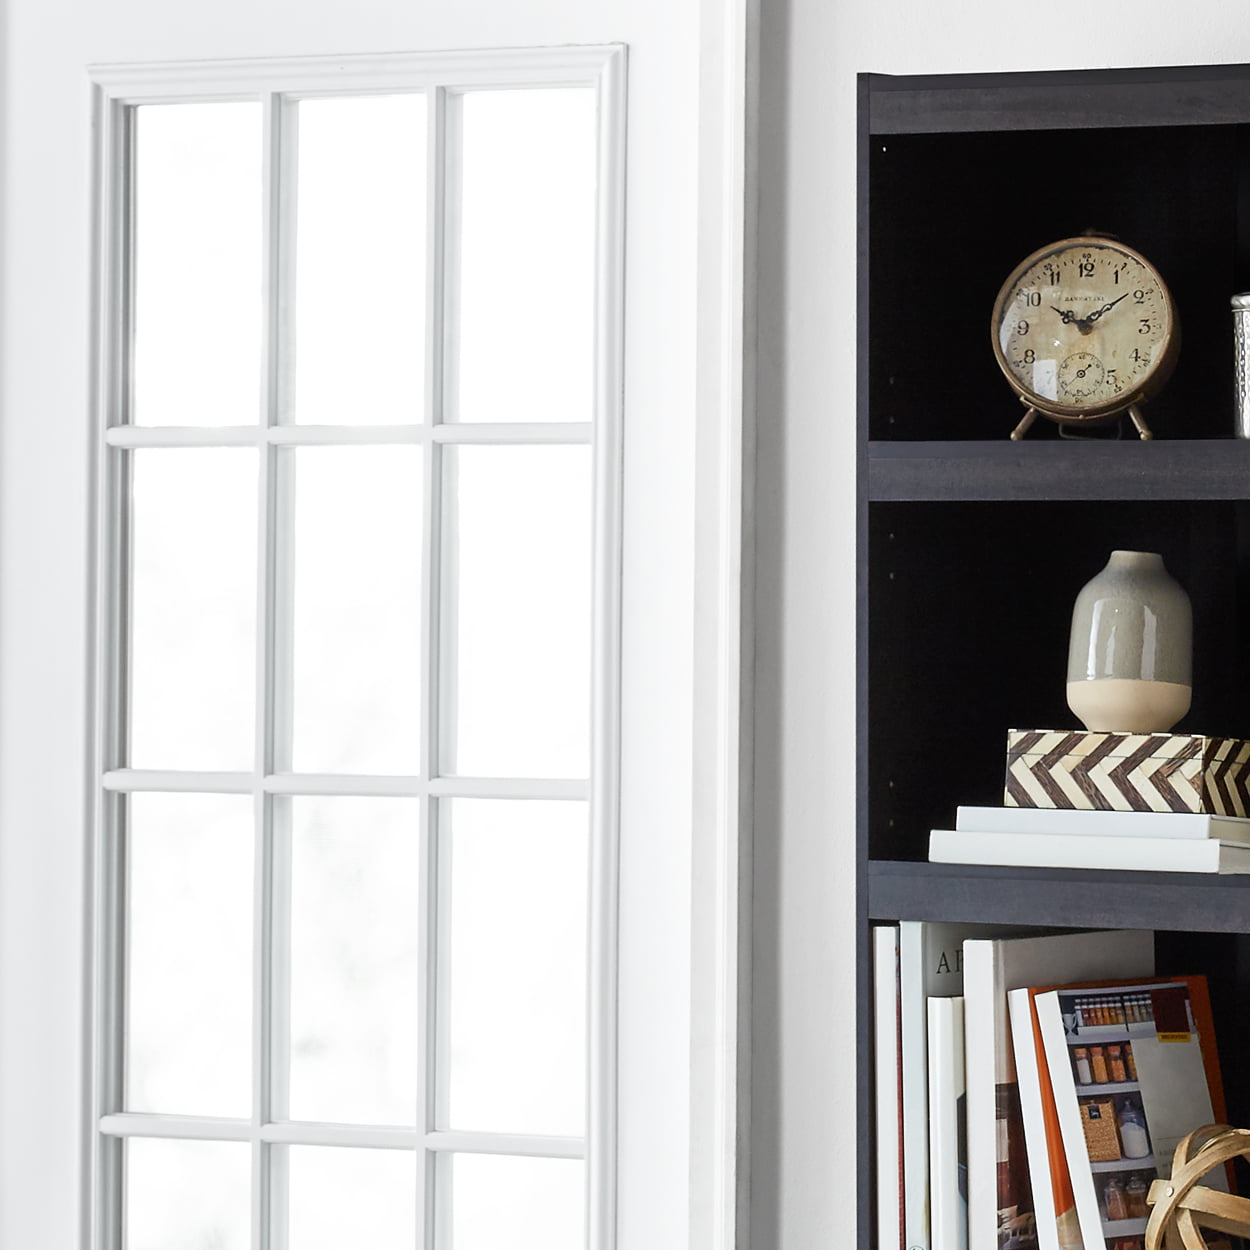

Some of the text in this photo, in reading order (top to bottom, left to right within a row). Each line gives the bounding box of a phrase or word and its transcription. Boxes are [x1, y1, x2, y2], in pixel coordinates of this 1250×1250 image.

[1049, 270, 1061, 286] 11
[1079, 262, 1095, 278] 12
[1113, 269, 1119, 285] 1
[1026, 291, 1042, 307] 10
[1133, 289, 1145, 305] 2
[1017, 319, 1030, 336] 9
[1138, 318, 1151, 335] 3
[1023, 348, 1036, 364] 8
[1128, 348, 1141, 362] 4
[1106, 369, 1117, 385] 5
